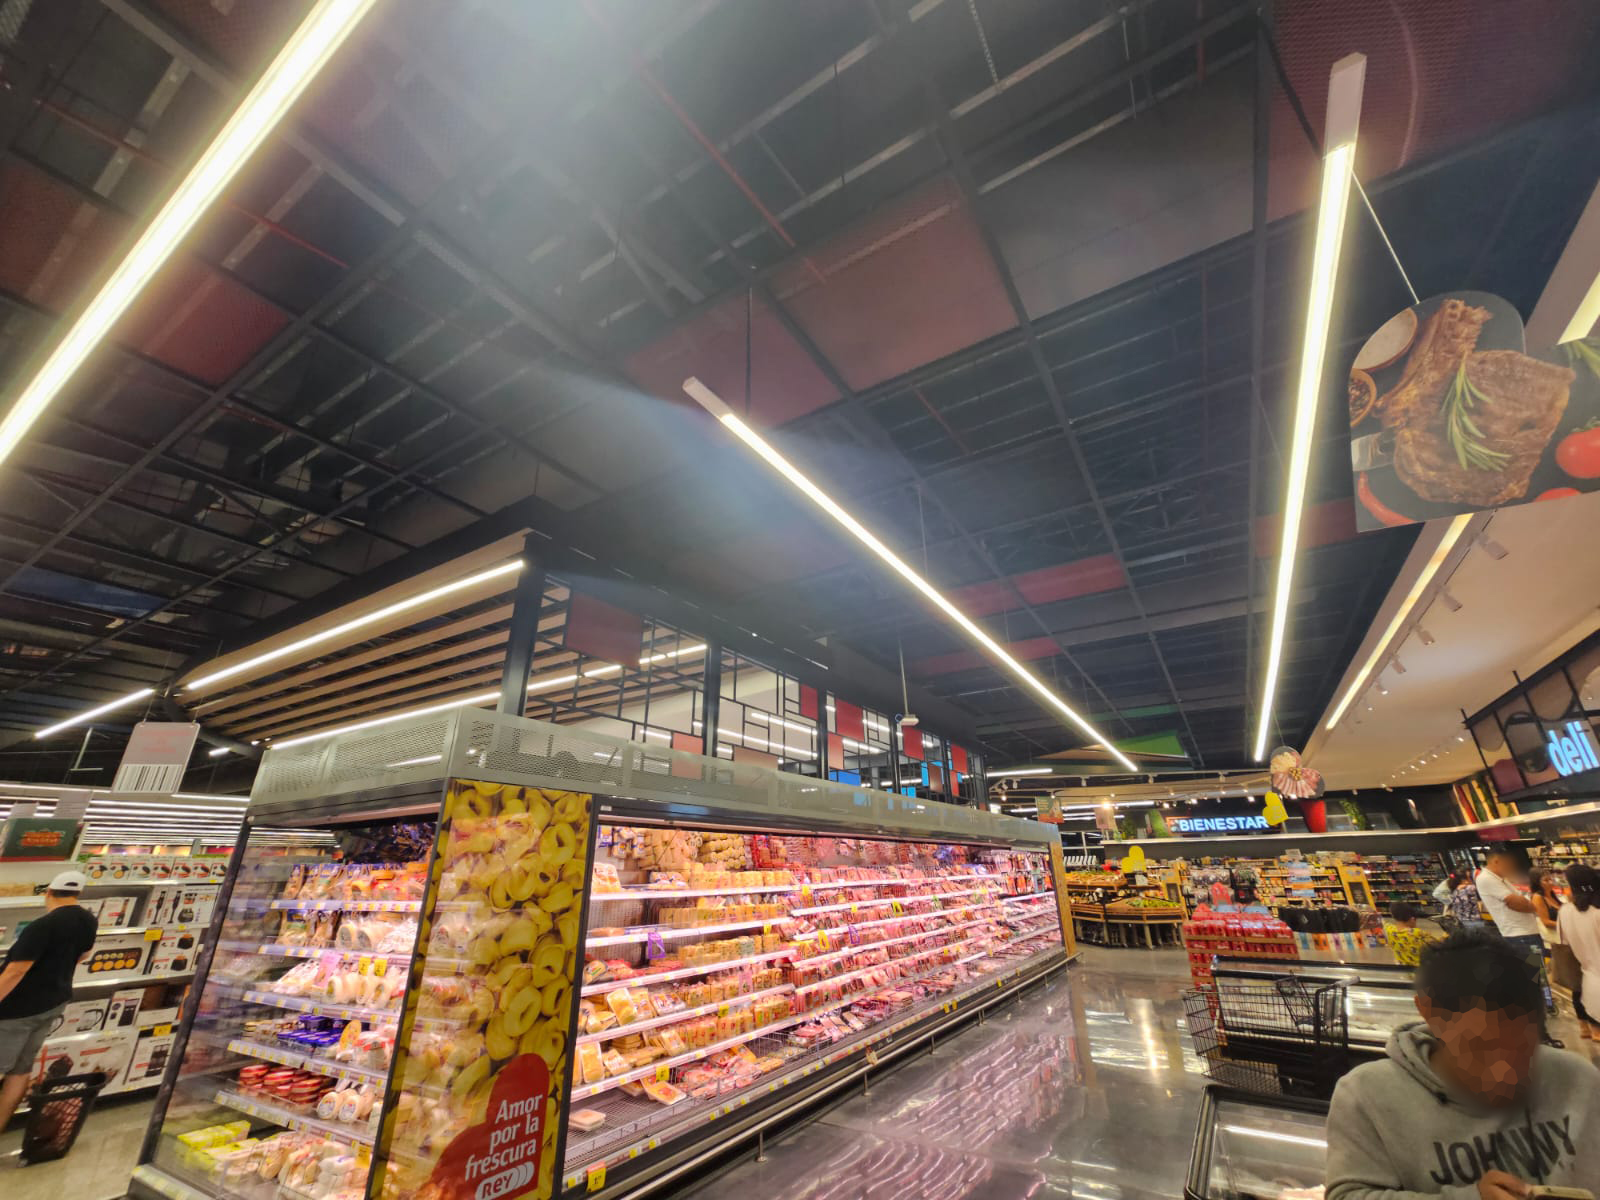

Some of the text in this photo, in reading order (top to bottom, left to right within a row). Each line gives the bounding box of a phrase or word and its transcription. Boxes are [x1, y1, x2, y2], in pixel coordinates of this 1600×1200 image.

[1547, 720, 1599, 776] deli
[1179, 815, 1269, 832] BIENESTAR
[495, 1094, 543, 1124] Amor
[489, 1113, 539, 1155] por la
[465, 1138, 536, 1182] frescura
